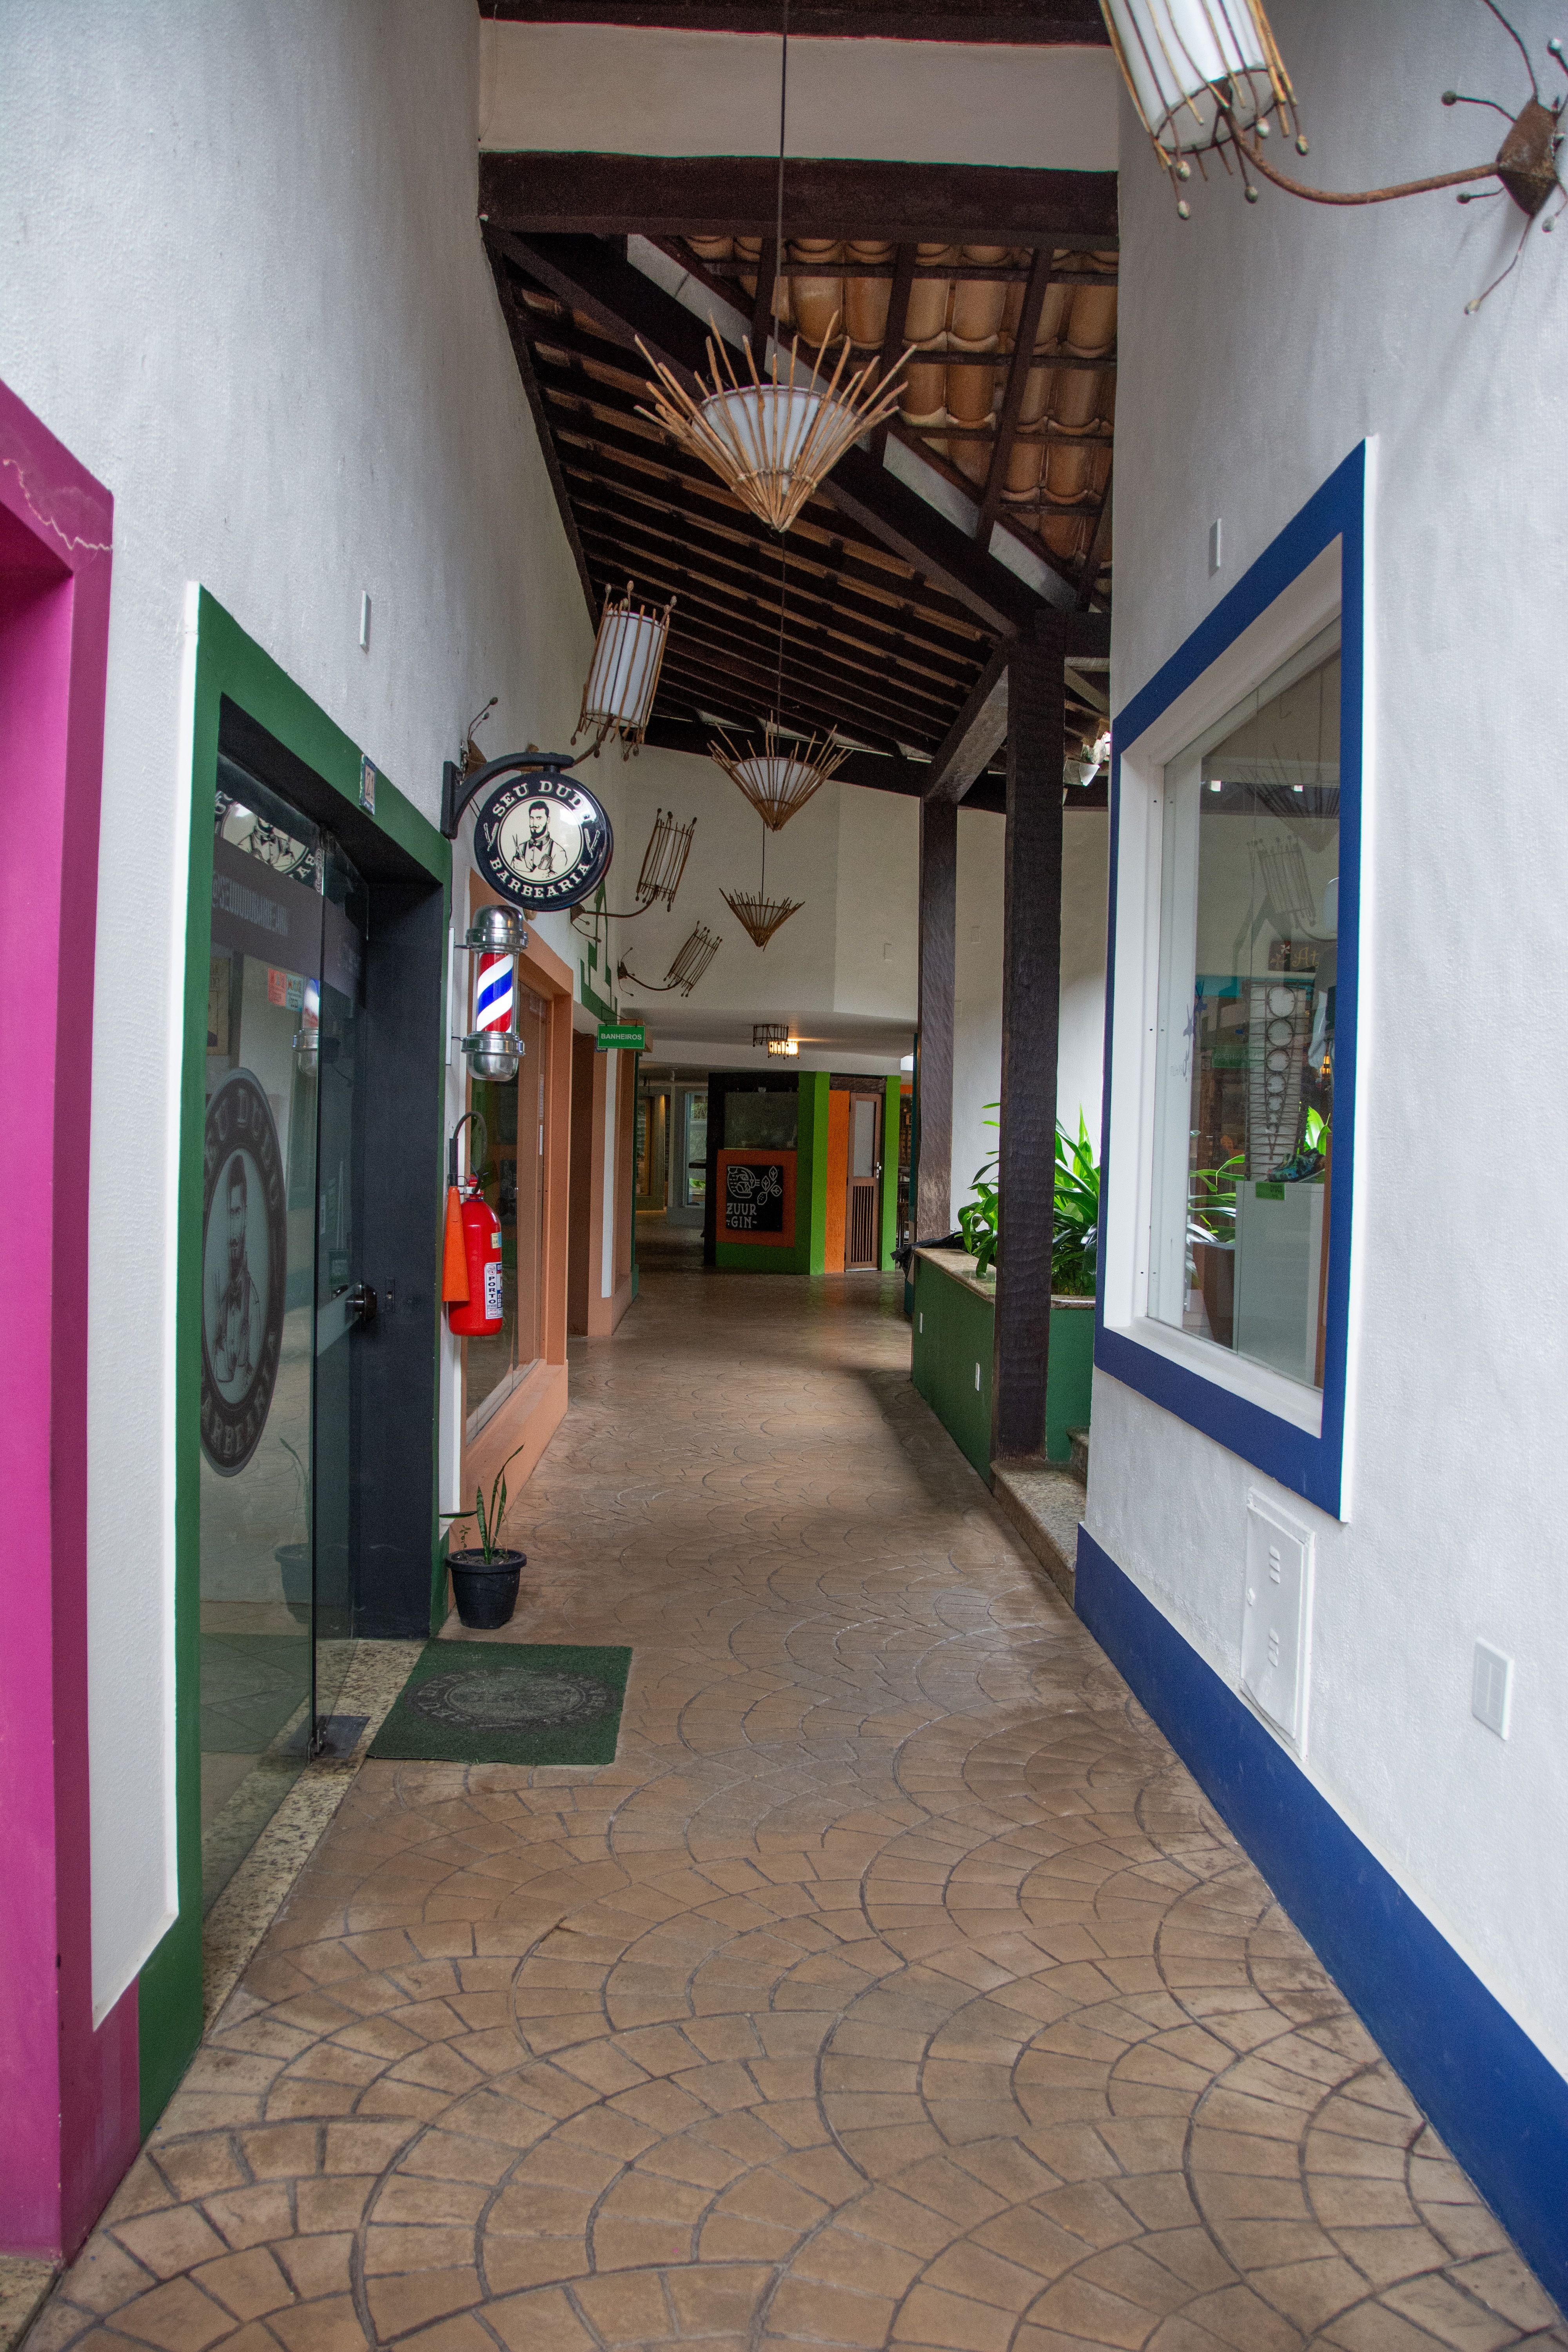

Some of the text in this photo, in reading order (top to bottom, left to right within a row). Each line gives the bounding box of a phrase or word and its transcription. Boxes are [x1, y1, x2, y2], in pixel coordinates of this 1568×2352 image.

[492, 780, 596, 823] SEU DUDU
[490, 857, 591, 899] BARBEARIA
[726, 1203, 757, 1215] ZUUR
[488, 1276, 496, 1304] PORTO
